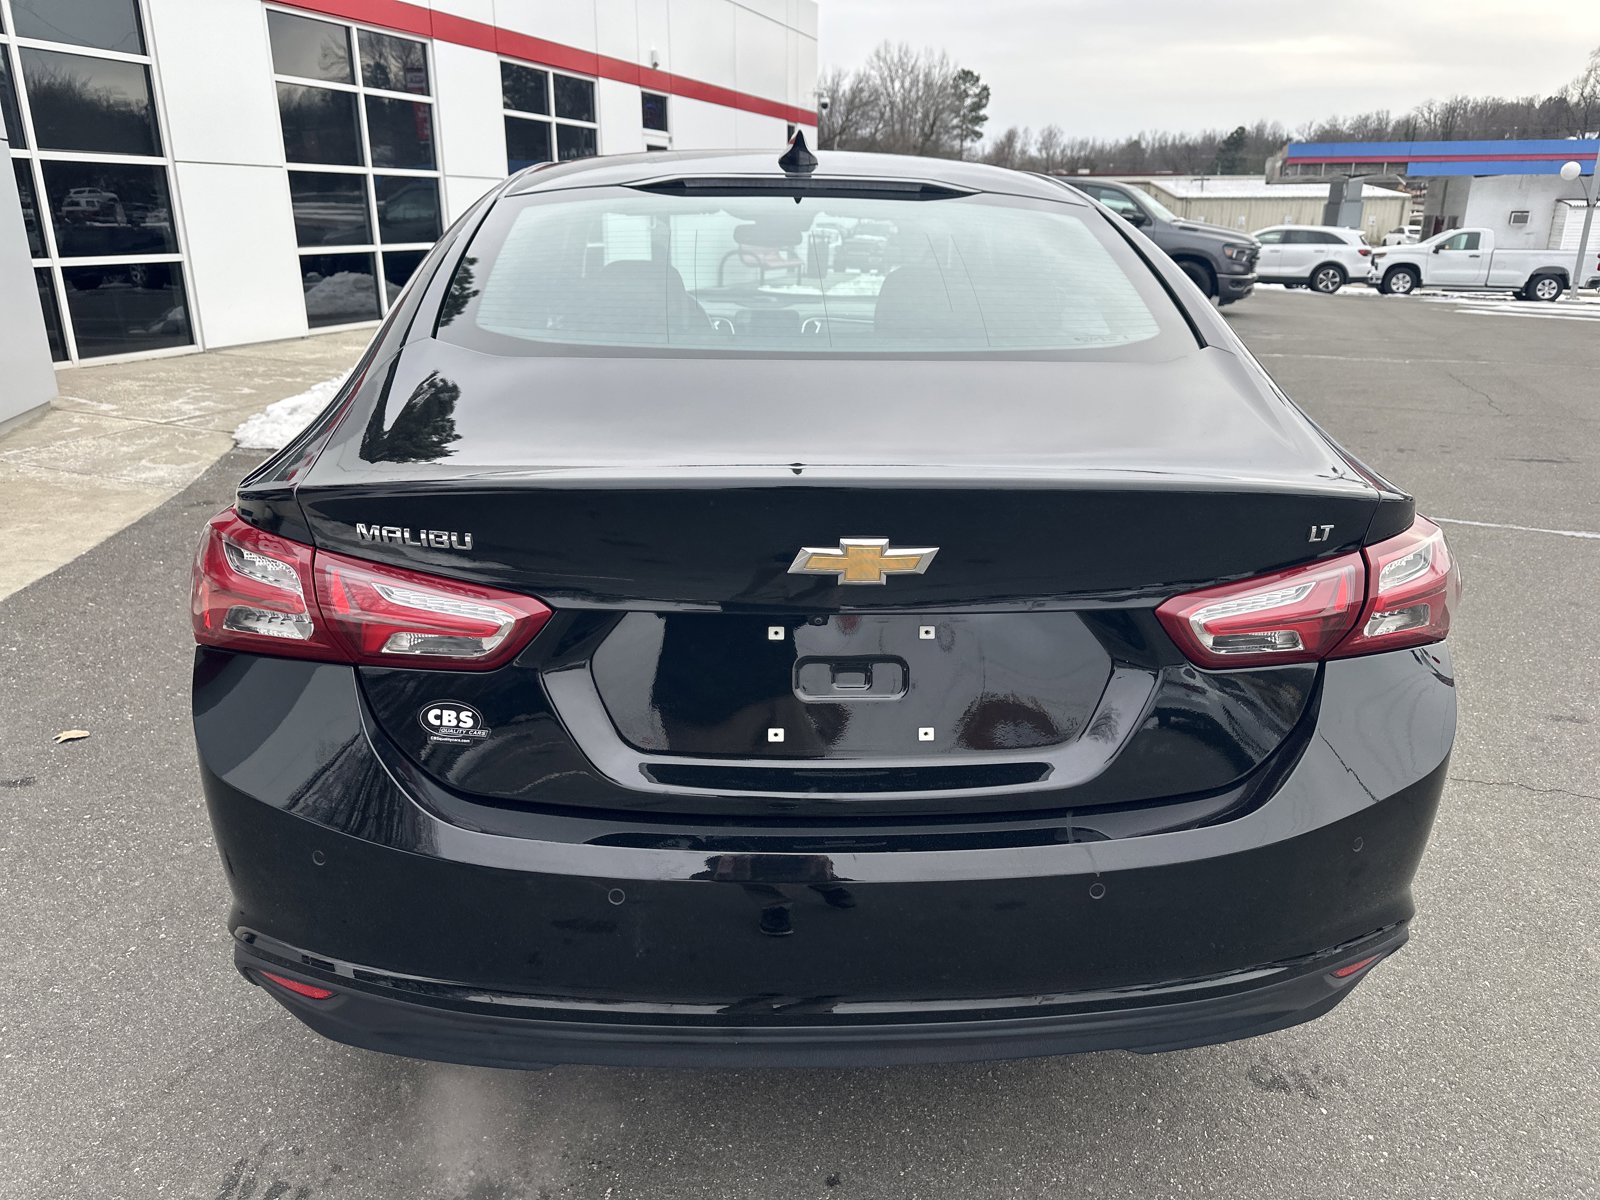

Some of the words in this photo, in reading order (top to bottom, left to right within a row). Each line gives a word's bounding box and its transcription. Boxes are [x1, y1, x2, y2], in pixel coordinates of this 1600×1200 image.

[356, 523, 473, 550] MALIBU
[1308, 524, 1335, 542] LT
[427, 708, 474, 728] CBS
[468, 729, 487, 737] CARS
